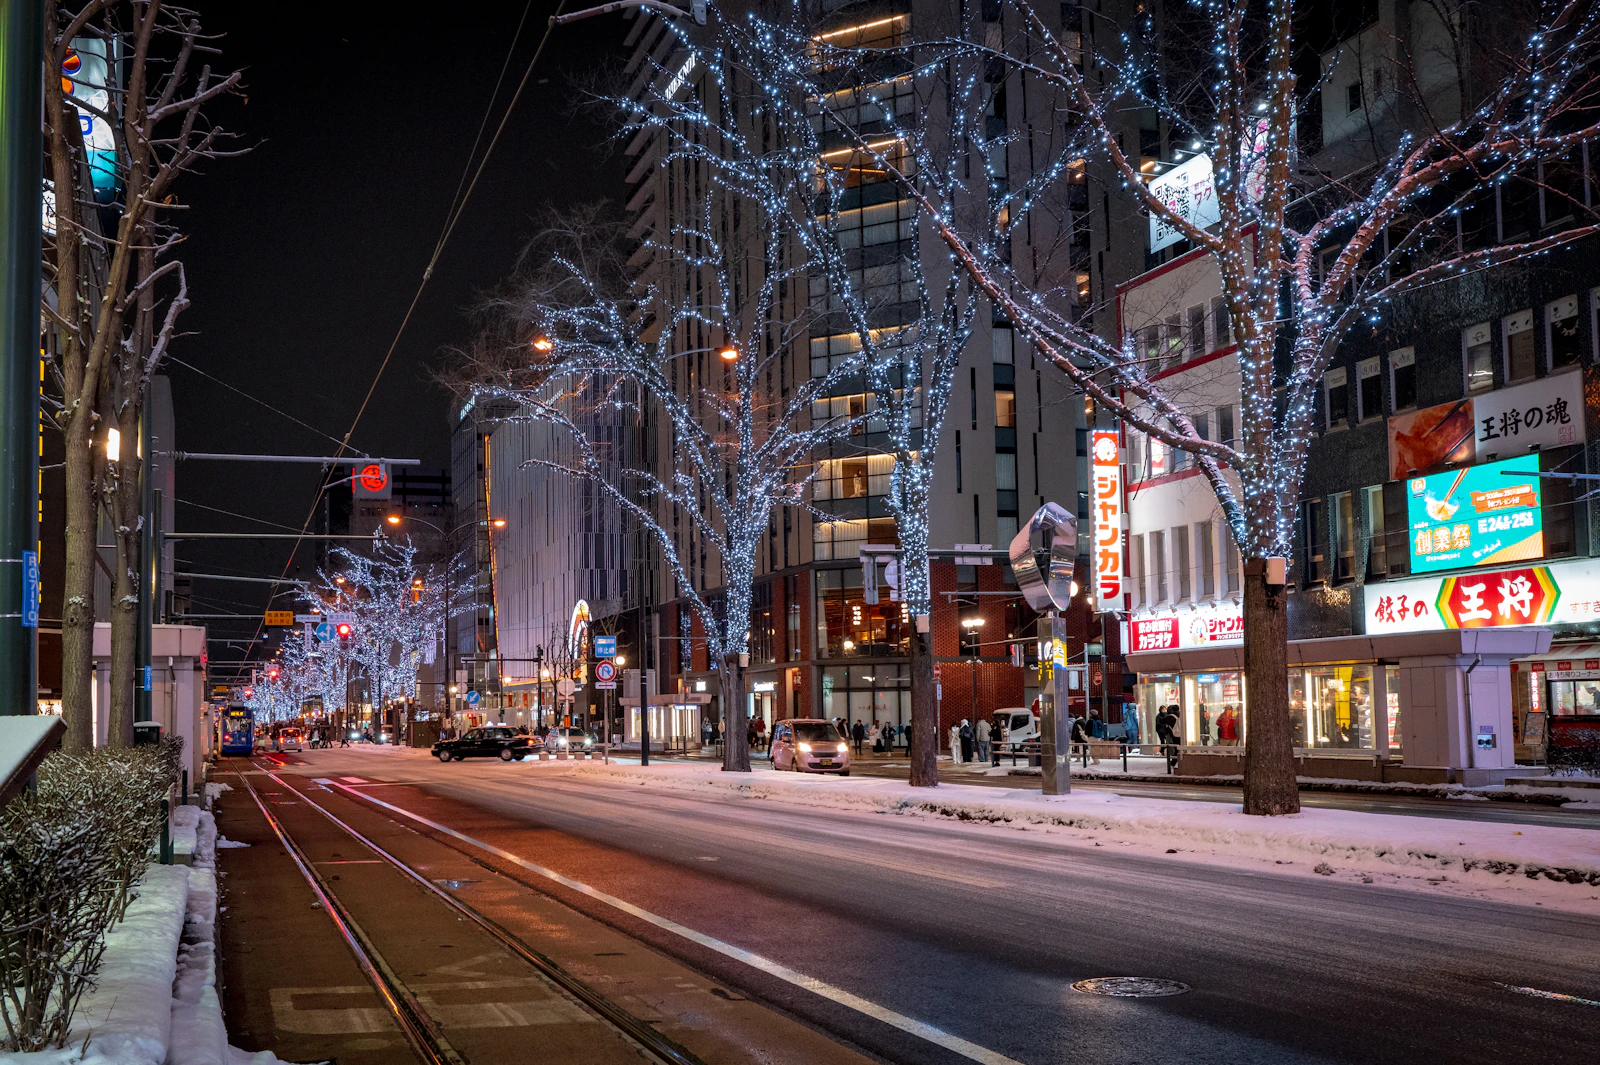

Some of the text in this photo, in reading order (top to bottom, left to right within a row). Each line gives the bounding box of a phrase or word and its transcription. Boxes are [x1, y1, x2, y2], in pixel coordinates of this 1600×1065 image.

[1479, 397, 1571, 442] 王将の魂
[1097, 474, 1120, 600] ジャンカラ
[1415, 524, 1471, 555] 創業祭
[1375, 575, 1534, 623] 餃子の 王将
[1138, 632, 1173, 650] カラオケ
[1548, 670, 1599, 679] お持ち帰りコーナー
